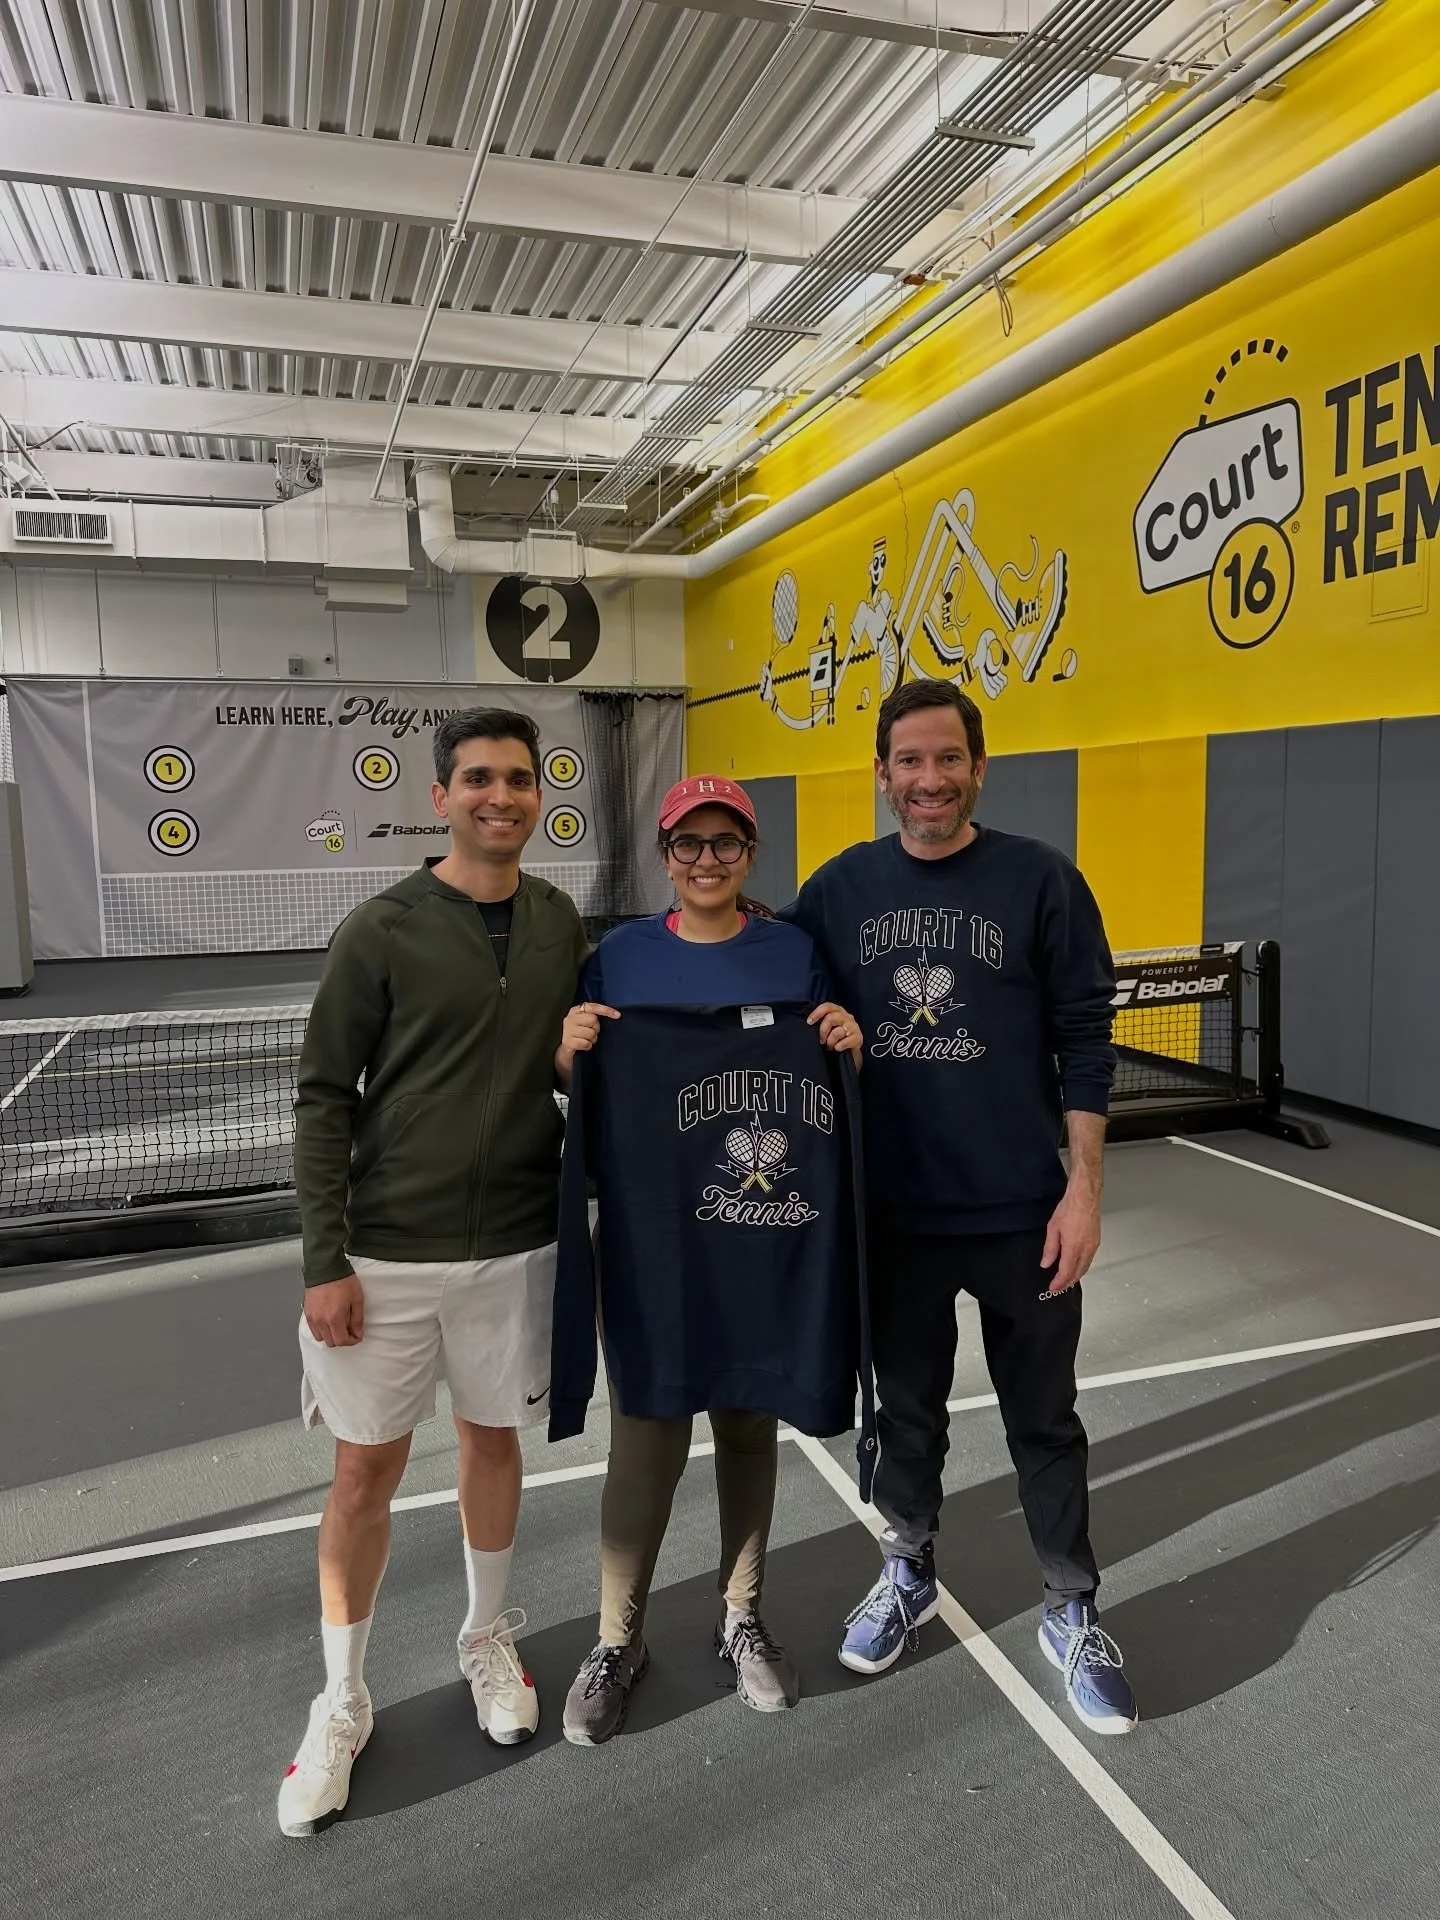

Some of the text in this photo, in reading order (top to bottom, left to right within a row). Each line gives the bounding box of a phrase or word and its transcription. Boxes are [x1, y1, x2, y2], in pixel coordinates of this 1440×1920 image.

[1145, 423, 1289, 562] Court
[1223, 545, 1276, 619] 16
[519, 586, 571, 660] 2
[215, 706, 275, 725] LEARN
[281, 706, 334, 728] HERE,
[338, 695, 420, 739] Play
[164, 762, 173, 776] 1
[372, 761, 382, 775] 2
[559, 762, 568, 775] 3
[698, 780, 716, 793] H
[168, 825, 179, 839] 4
[308, 822, 342, 838] Court
[561, 819, 571, 832] 5
[328, 838, 341, 849] 16
[859, 907, 1004, 970] COURT 16
[1141, 967, 1185, 976] POWERED
[871, 1021, 987, 1062] Tennis
[678, 1070, 834, 1135] COURT 16
[696, 1185, 820, 1226] Tennis
